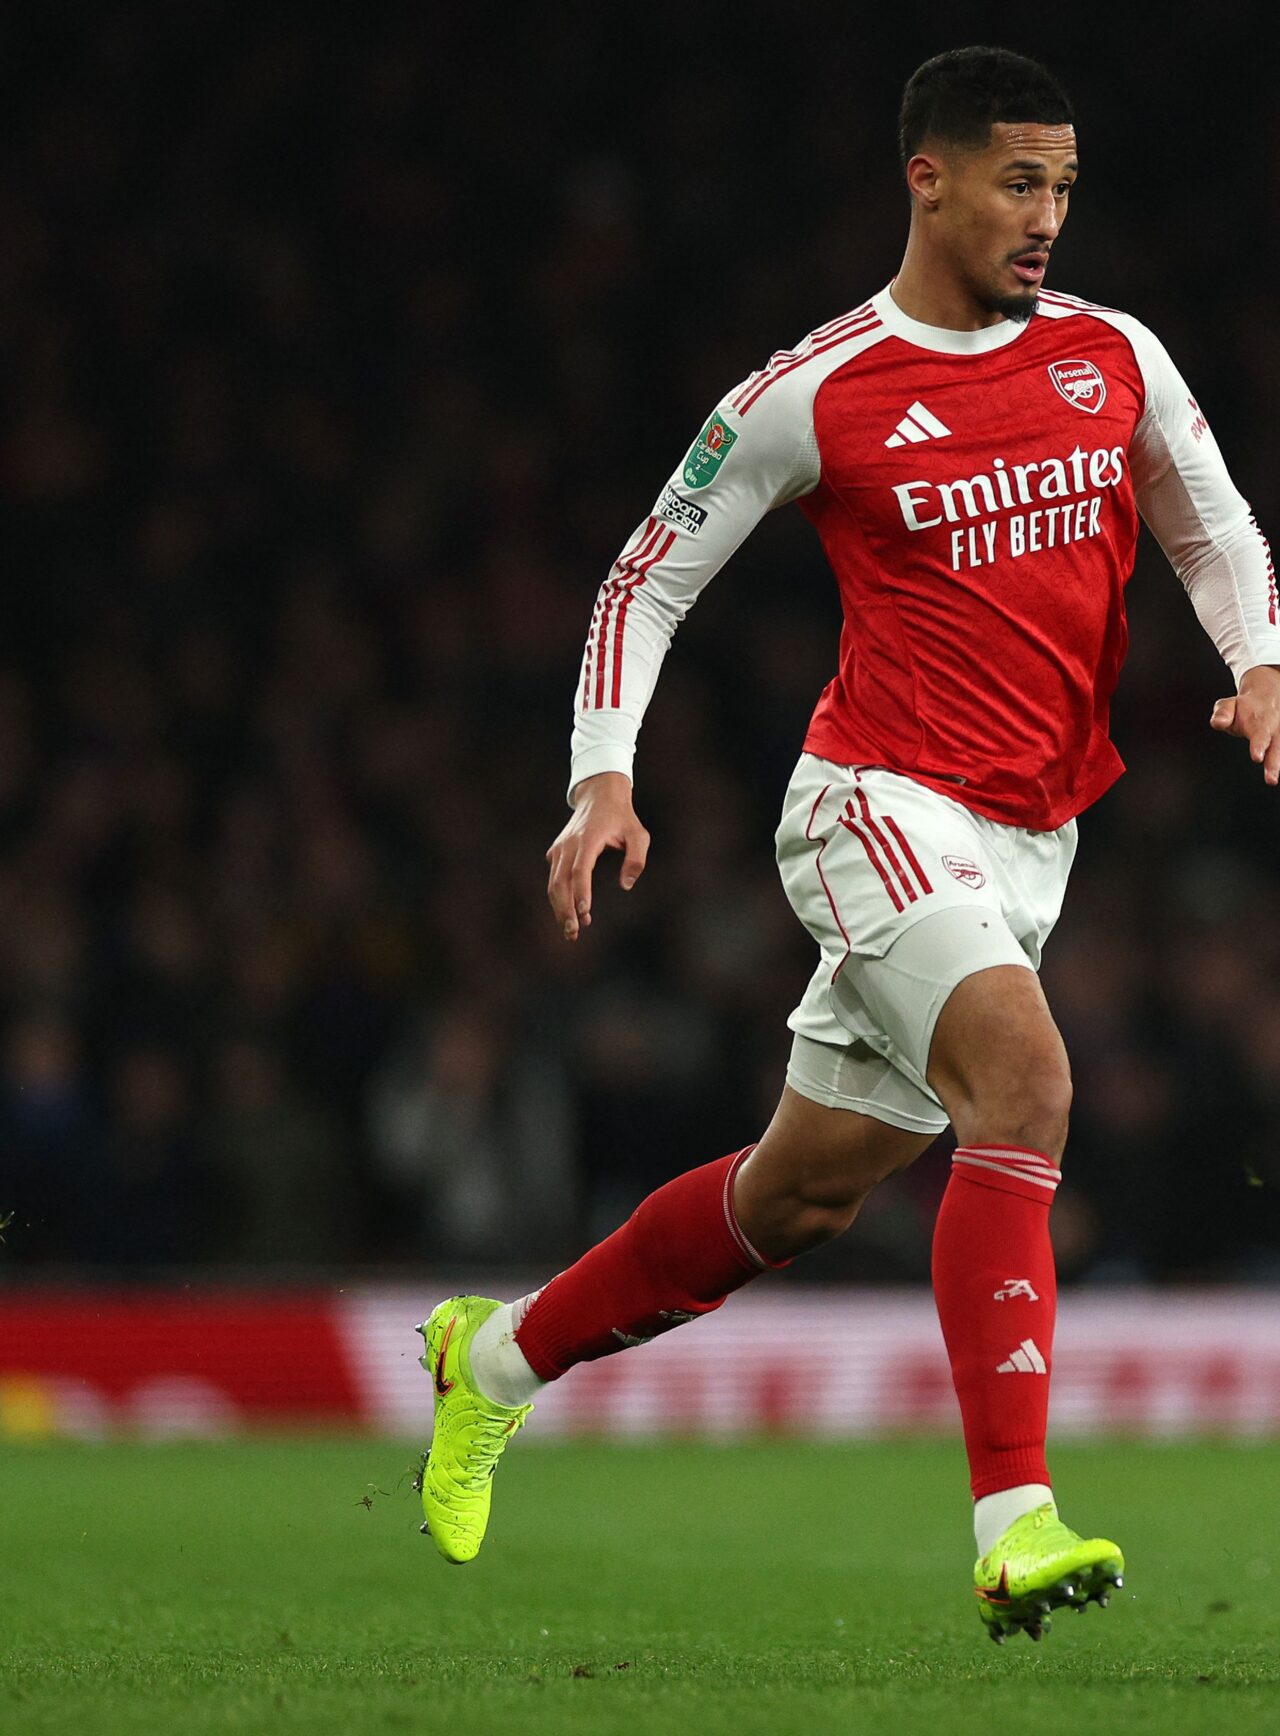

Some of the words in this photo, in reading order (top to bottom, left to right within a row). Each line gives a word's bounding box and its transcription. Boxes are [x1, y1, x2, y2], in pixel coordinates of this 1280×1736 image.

[1057, 365, 1093, 380] Arsenal
[696, 450, 709, 464] Cup
[891, 444, 1124, 532] Emirates
[662, 504, 700, 535] racism
[668, 495, 701, 522] room
[950, 520, 997, 571] FLY
[1008, 496, 1102, 558] BETTER
